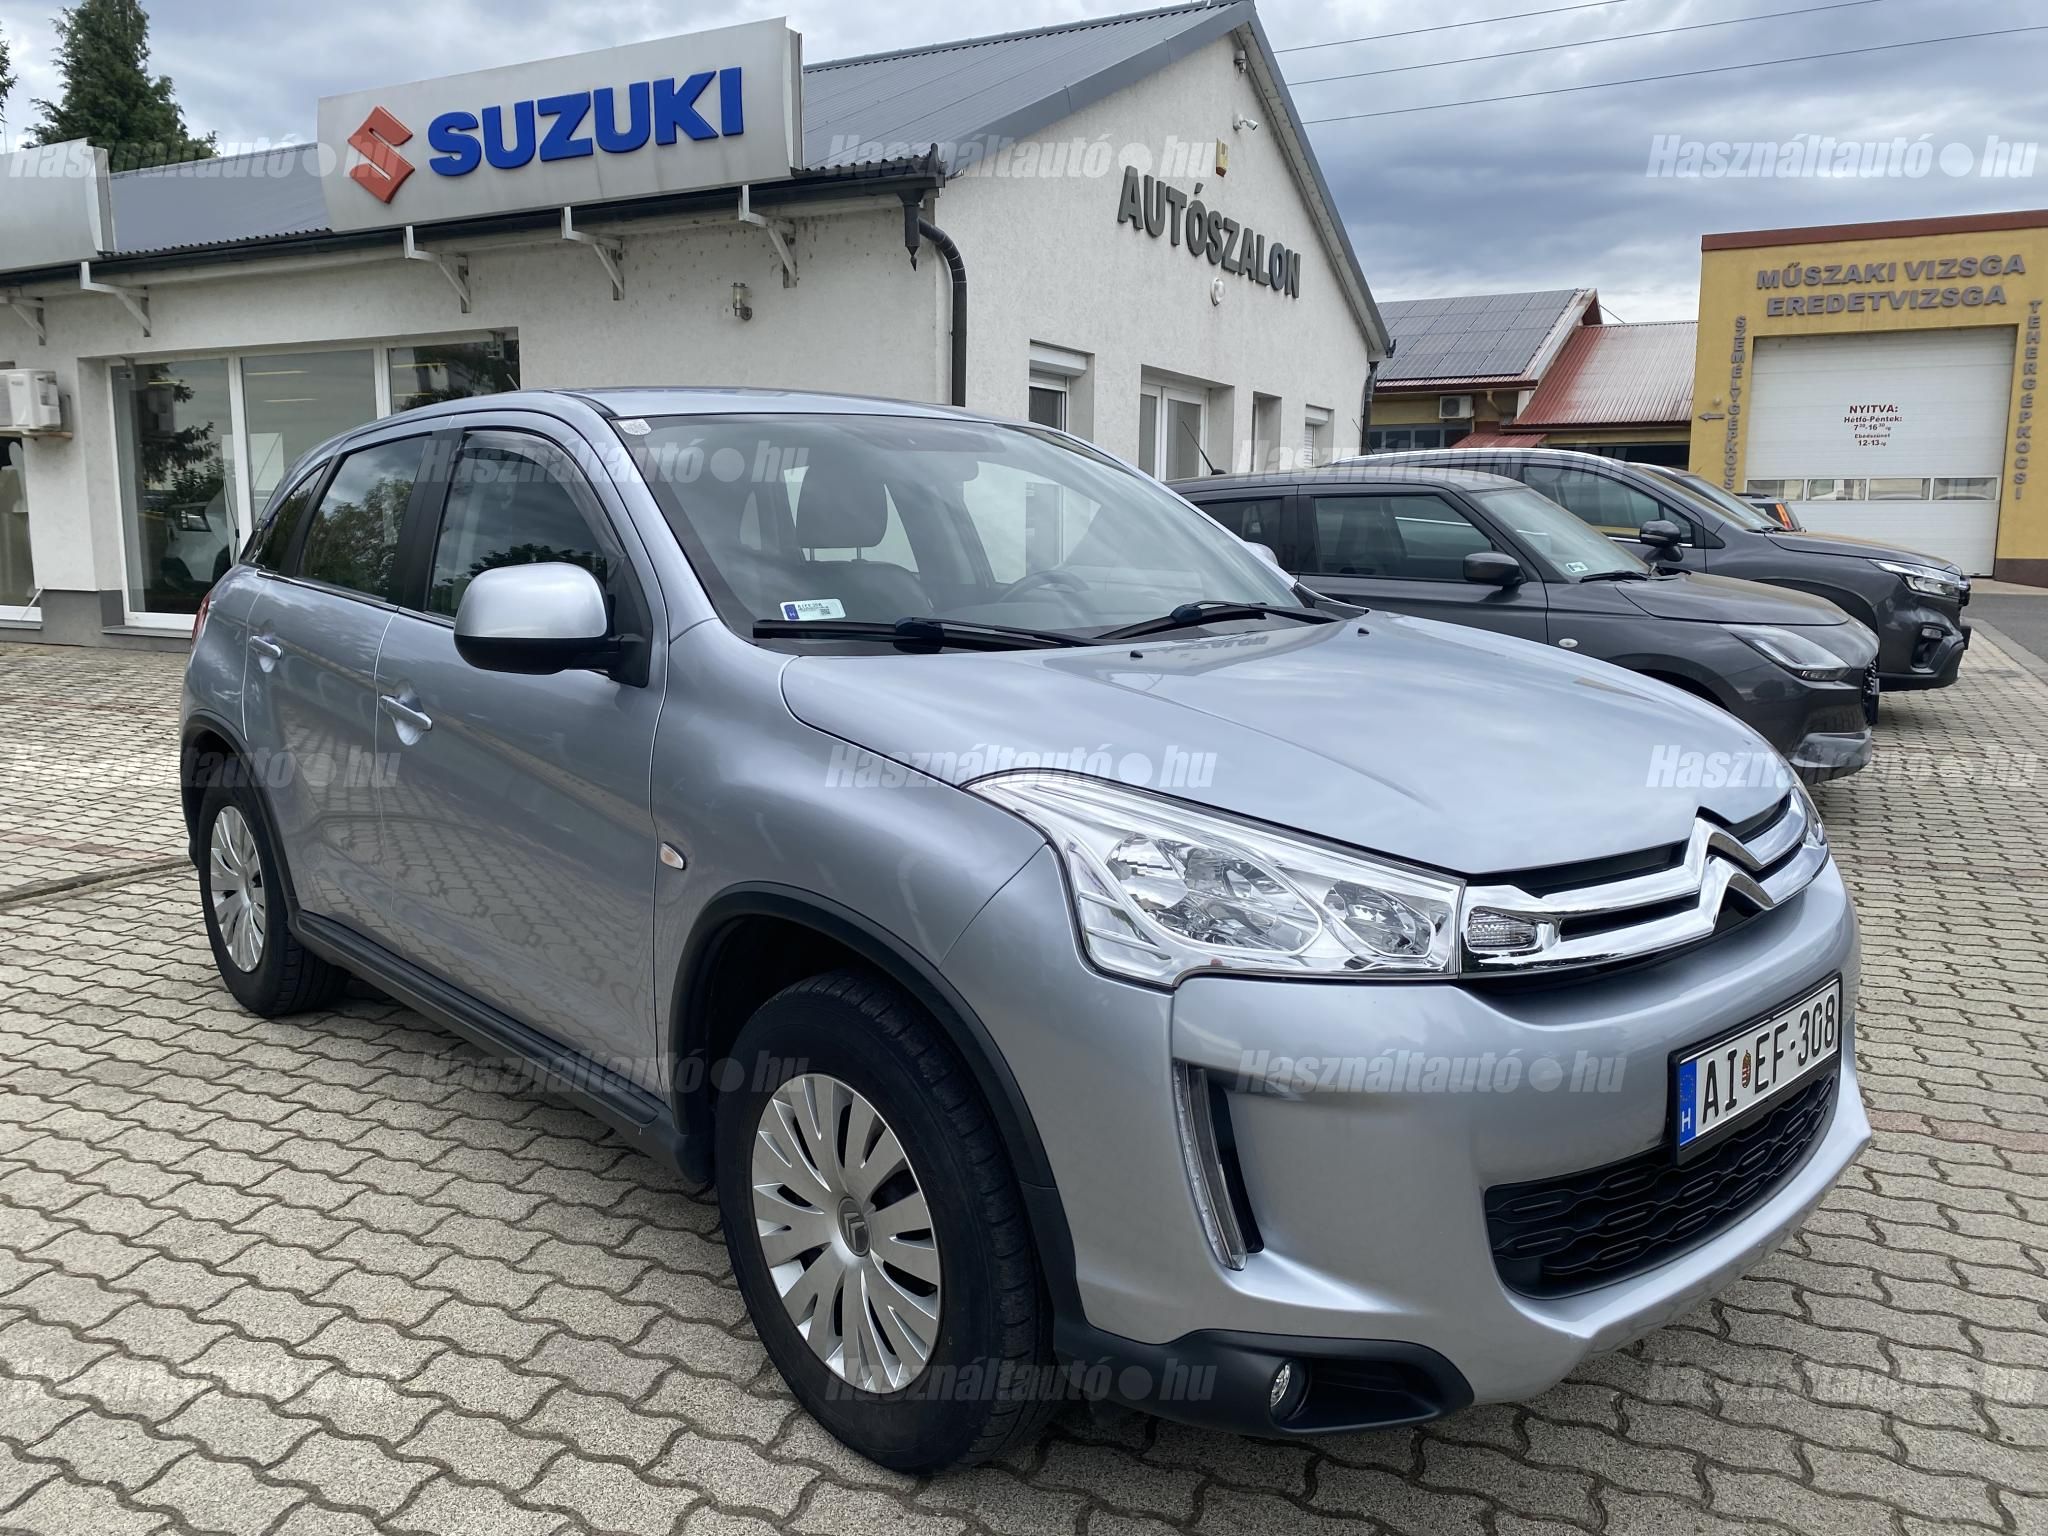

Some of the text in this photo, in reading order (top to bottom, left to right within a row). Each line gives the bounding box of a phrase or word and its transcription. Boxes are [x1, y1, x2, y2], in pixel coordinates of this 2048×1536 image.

[428, 66, 744, 177] SUZUKI
[1117, 165, 1301, 298] AUTÓSZALON
[1756, 254, 2026, 290] MŰSZAKI VIZSGA
[1766, 285, 2007, 317] EREDETVIZSGA
[1724, 315, 1746, 490] SZEMÉLYGÉPKOCS
[1849, 404, 1899, 414] NYITVA:
[2013, 300, 2042, 500] TEHERGÉPKOCSI
[1681, 1108, 1691, 1133] H
[1703, 1049, 1738, 1124] AI
